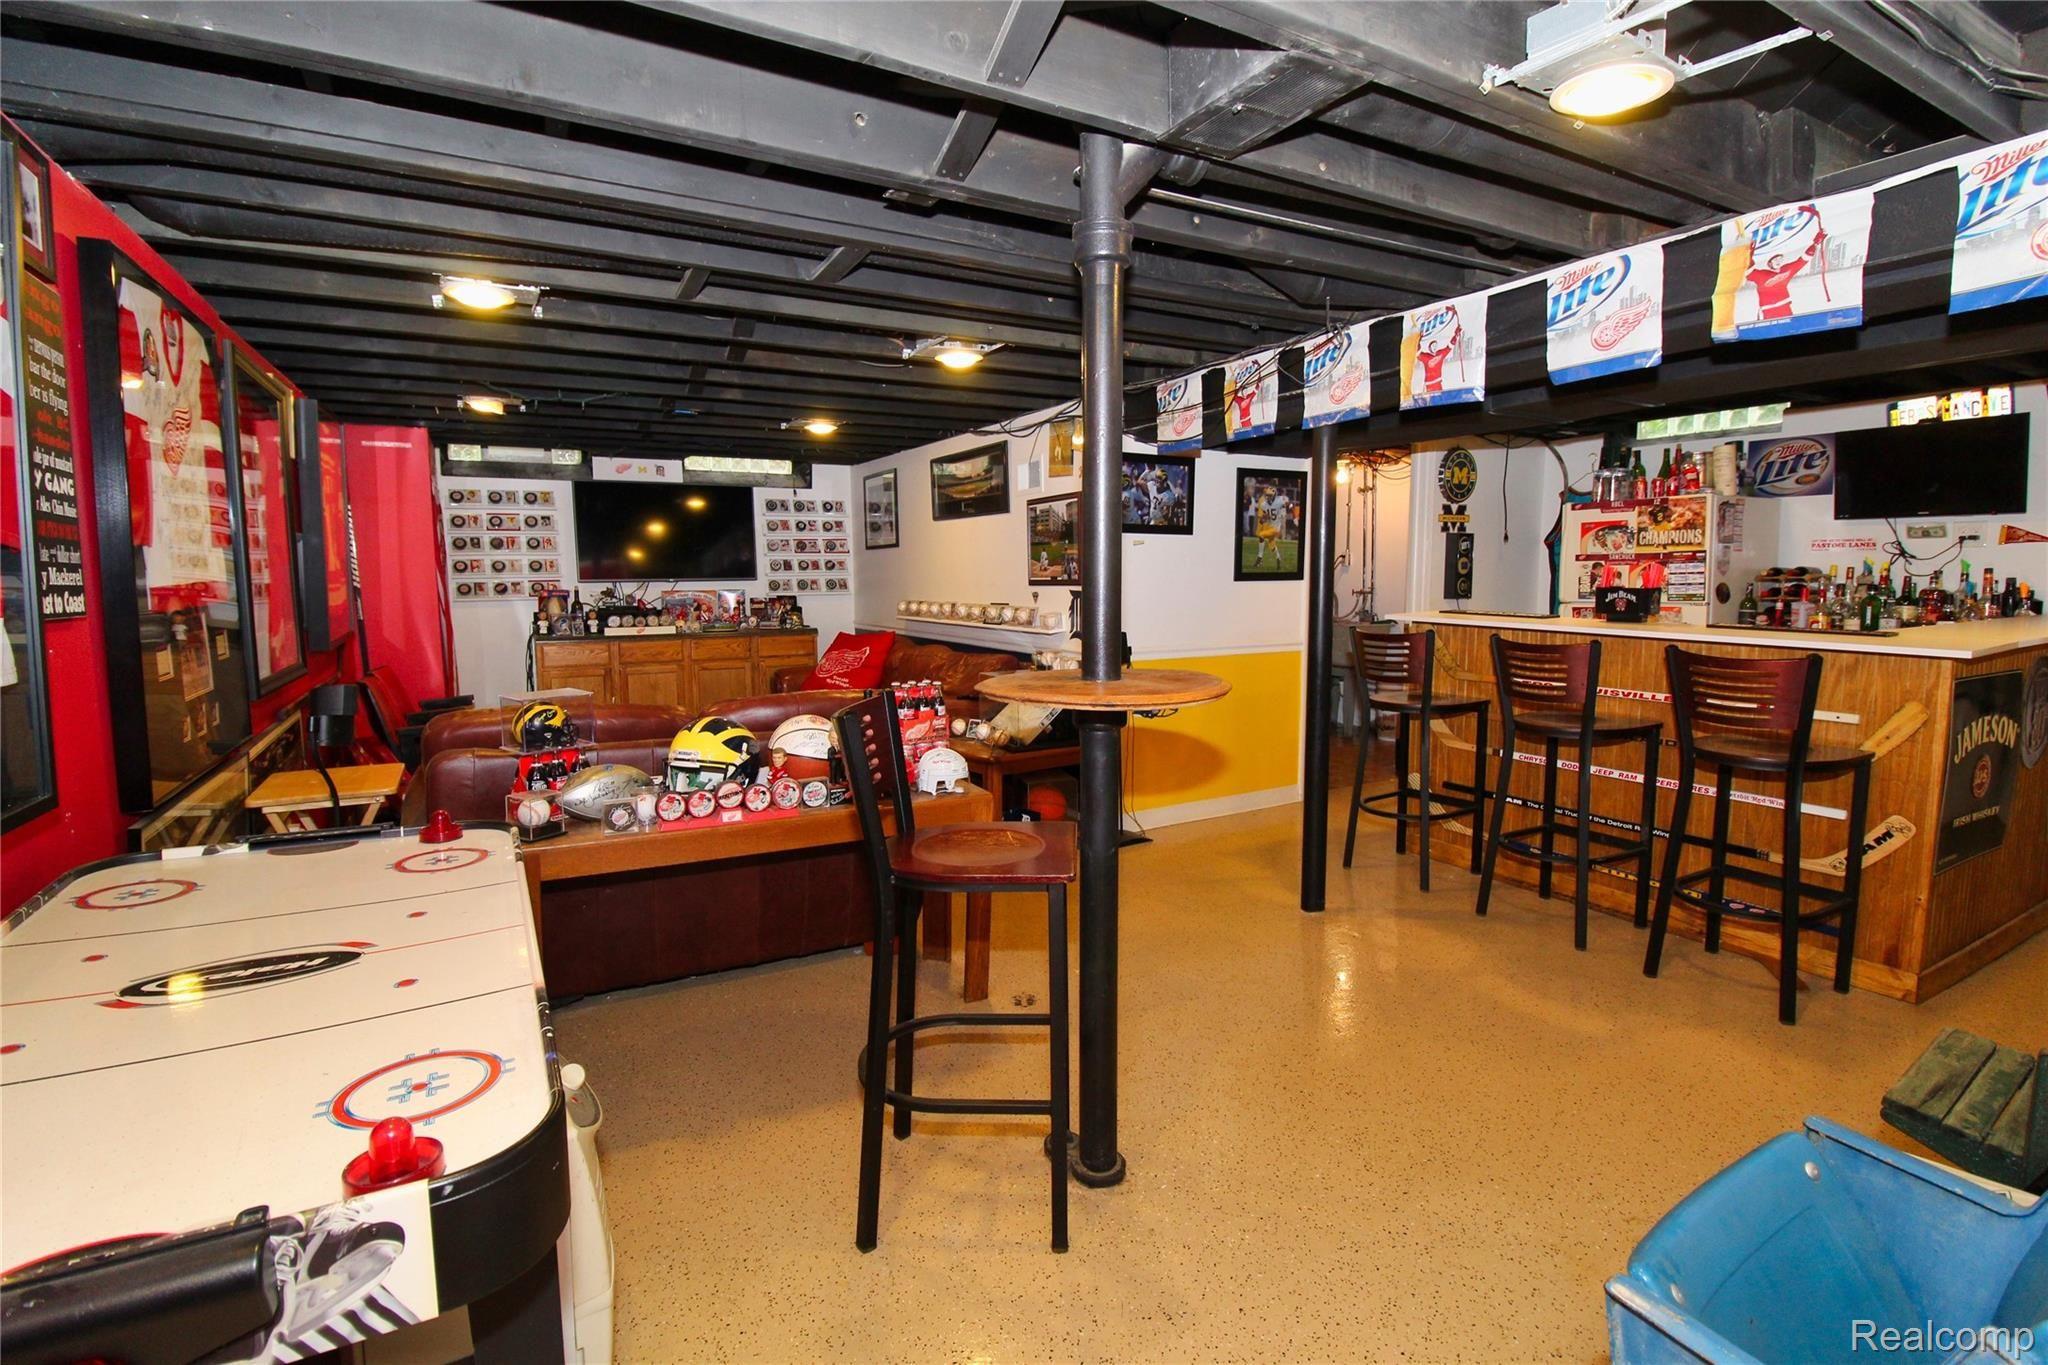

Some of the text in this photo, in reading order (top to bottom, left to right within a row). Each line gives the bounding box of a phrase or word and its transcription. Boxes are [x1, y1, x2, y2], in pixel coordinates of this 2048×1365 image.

[1971, 139, 2048, 184] Miller
[1555, 261, 1602, 290] Miller
[1548, 266, 1616, 328] Lite
[1775, 443, 1818, 460] Miller
[1756, 450, 1829, 487] Lite
[44, 473, 75, 497] GANG
[1638, 529, 1703, 546] CHAMPIONS
[48, 566, 84, 587] Mackerel
[64, 589, 86, 614] Coast
[1954, 713, 2017, 764] JAMESON
[1592, 768, 1615, 777] JEEP
[1618, 771, 1638, 781] RAM
[1526, 801, 1539, 809] The
[1564, 809, 1578, 818] Truc
[1593, 816, 1606, 824] the
[1606, 819, 1633, 830] Detroit
